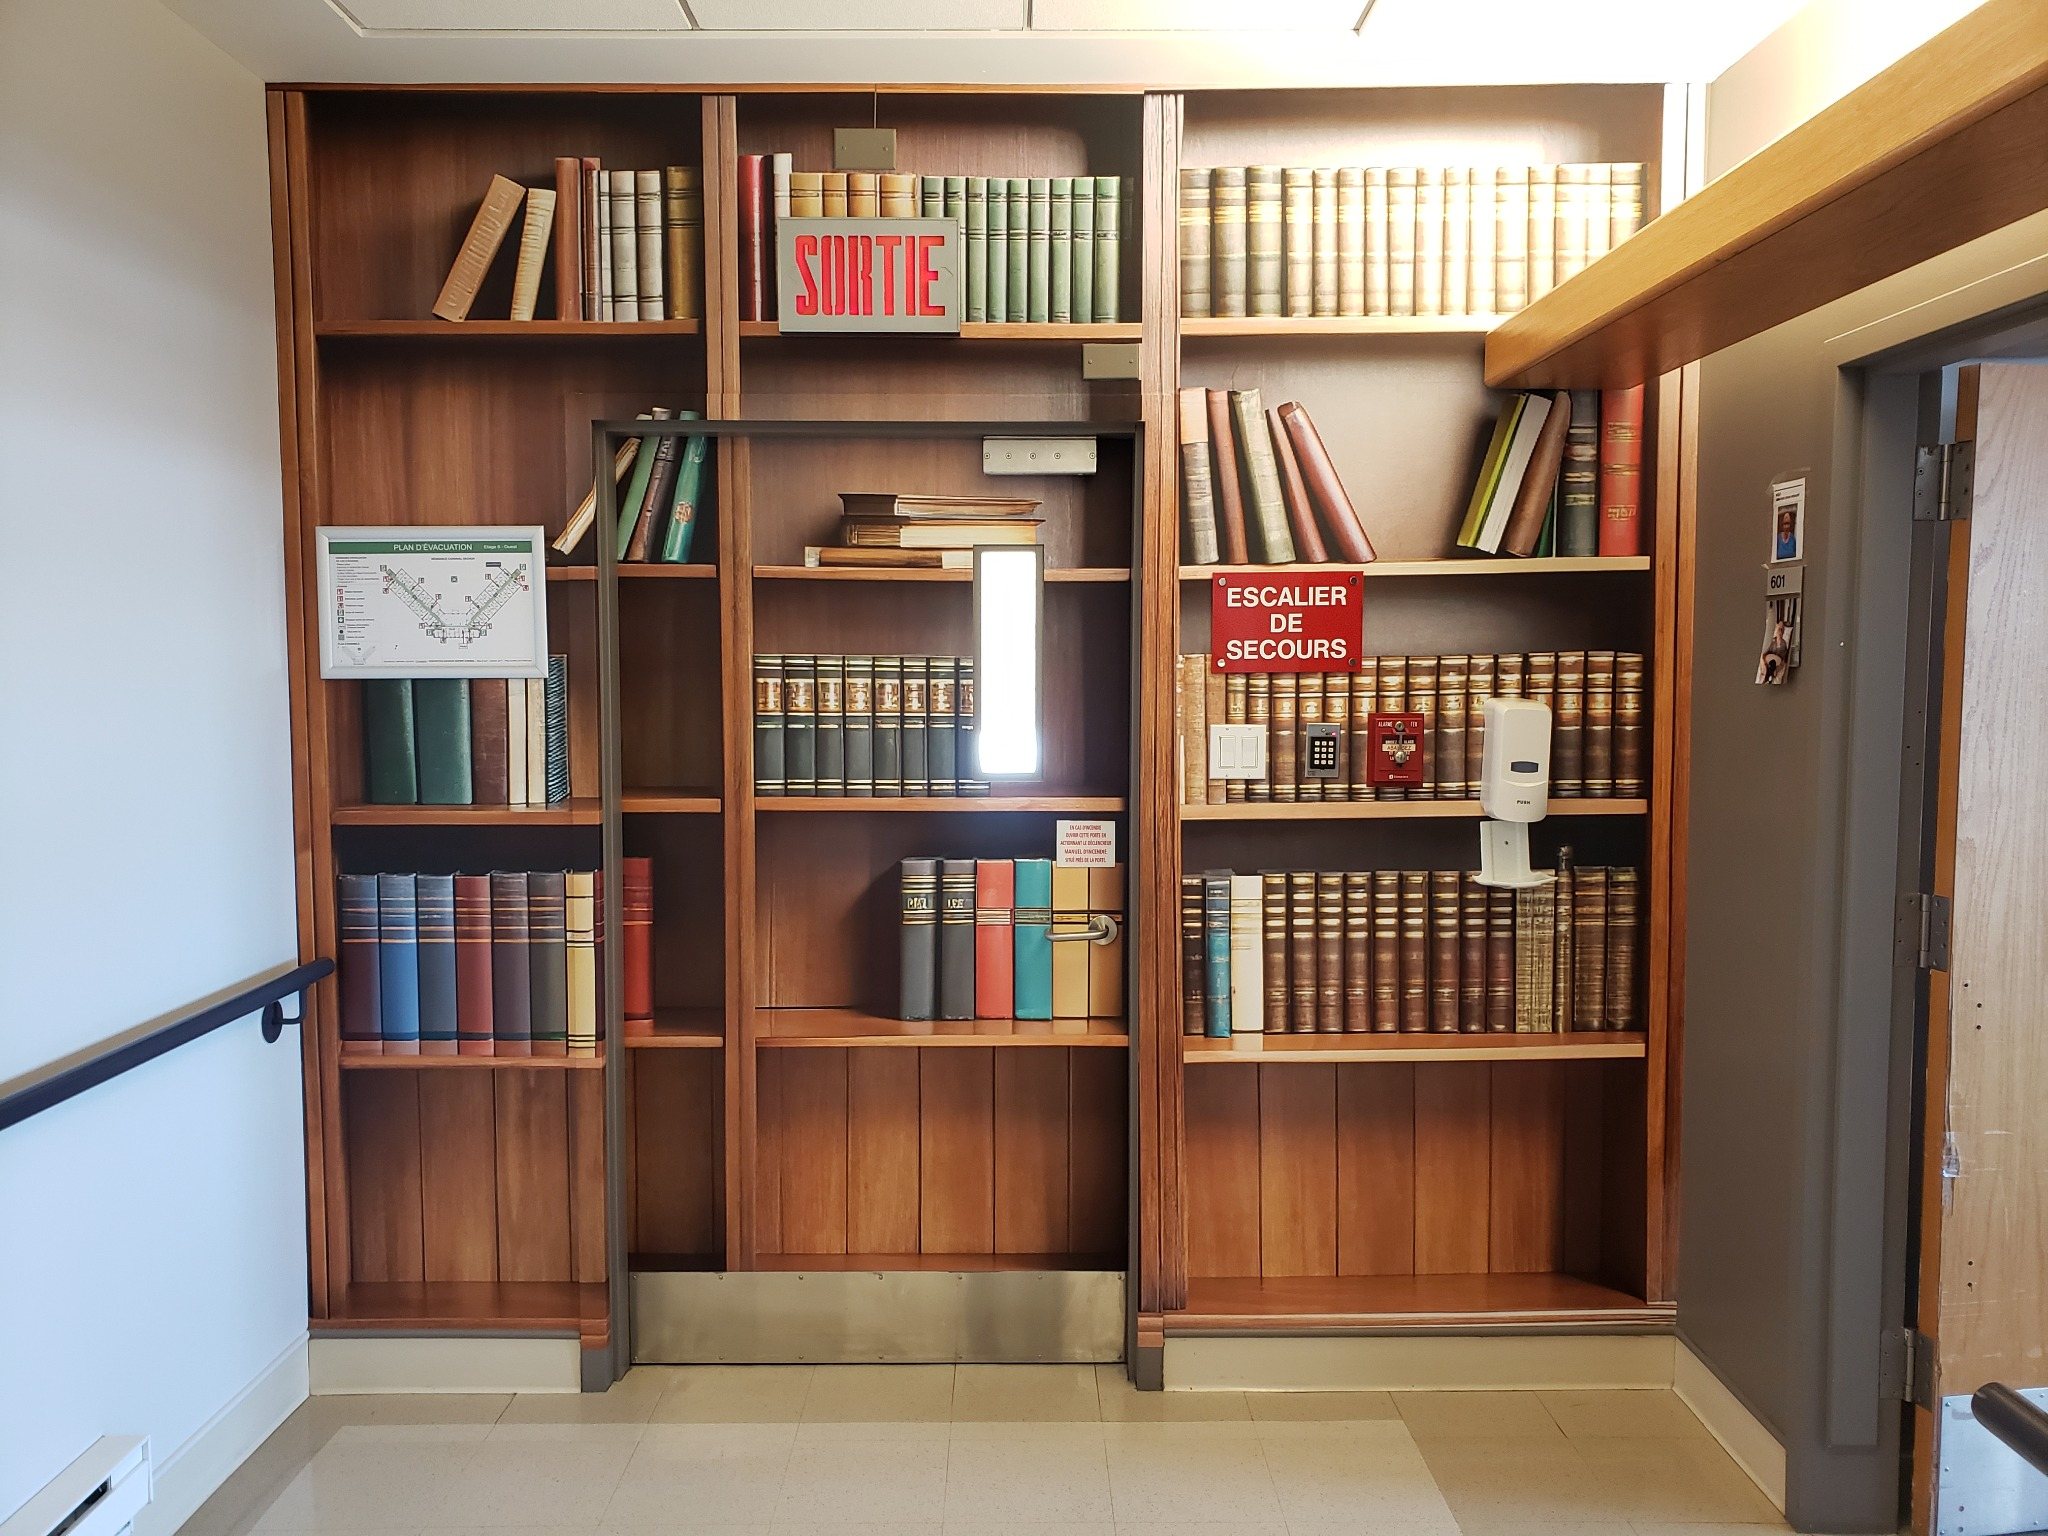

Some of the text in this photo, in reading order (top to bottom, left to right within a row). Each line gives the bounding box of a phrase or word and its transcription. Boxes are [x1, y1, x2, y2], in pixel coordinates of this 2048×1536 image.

[794, 234, 946, 317] SORTIE
[416, 543, 472, 551] D'ÉVACUATION
[1771, 575, 1785, 588] 601
[1227, 586, 1347, 607] ESCALIER
[1270, 613, 1303, 633] DE
[1226, 638, 1347, 660] SECOURS
